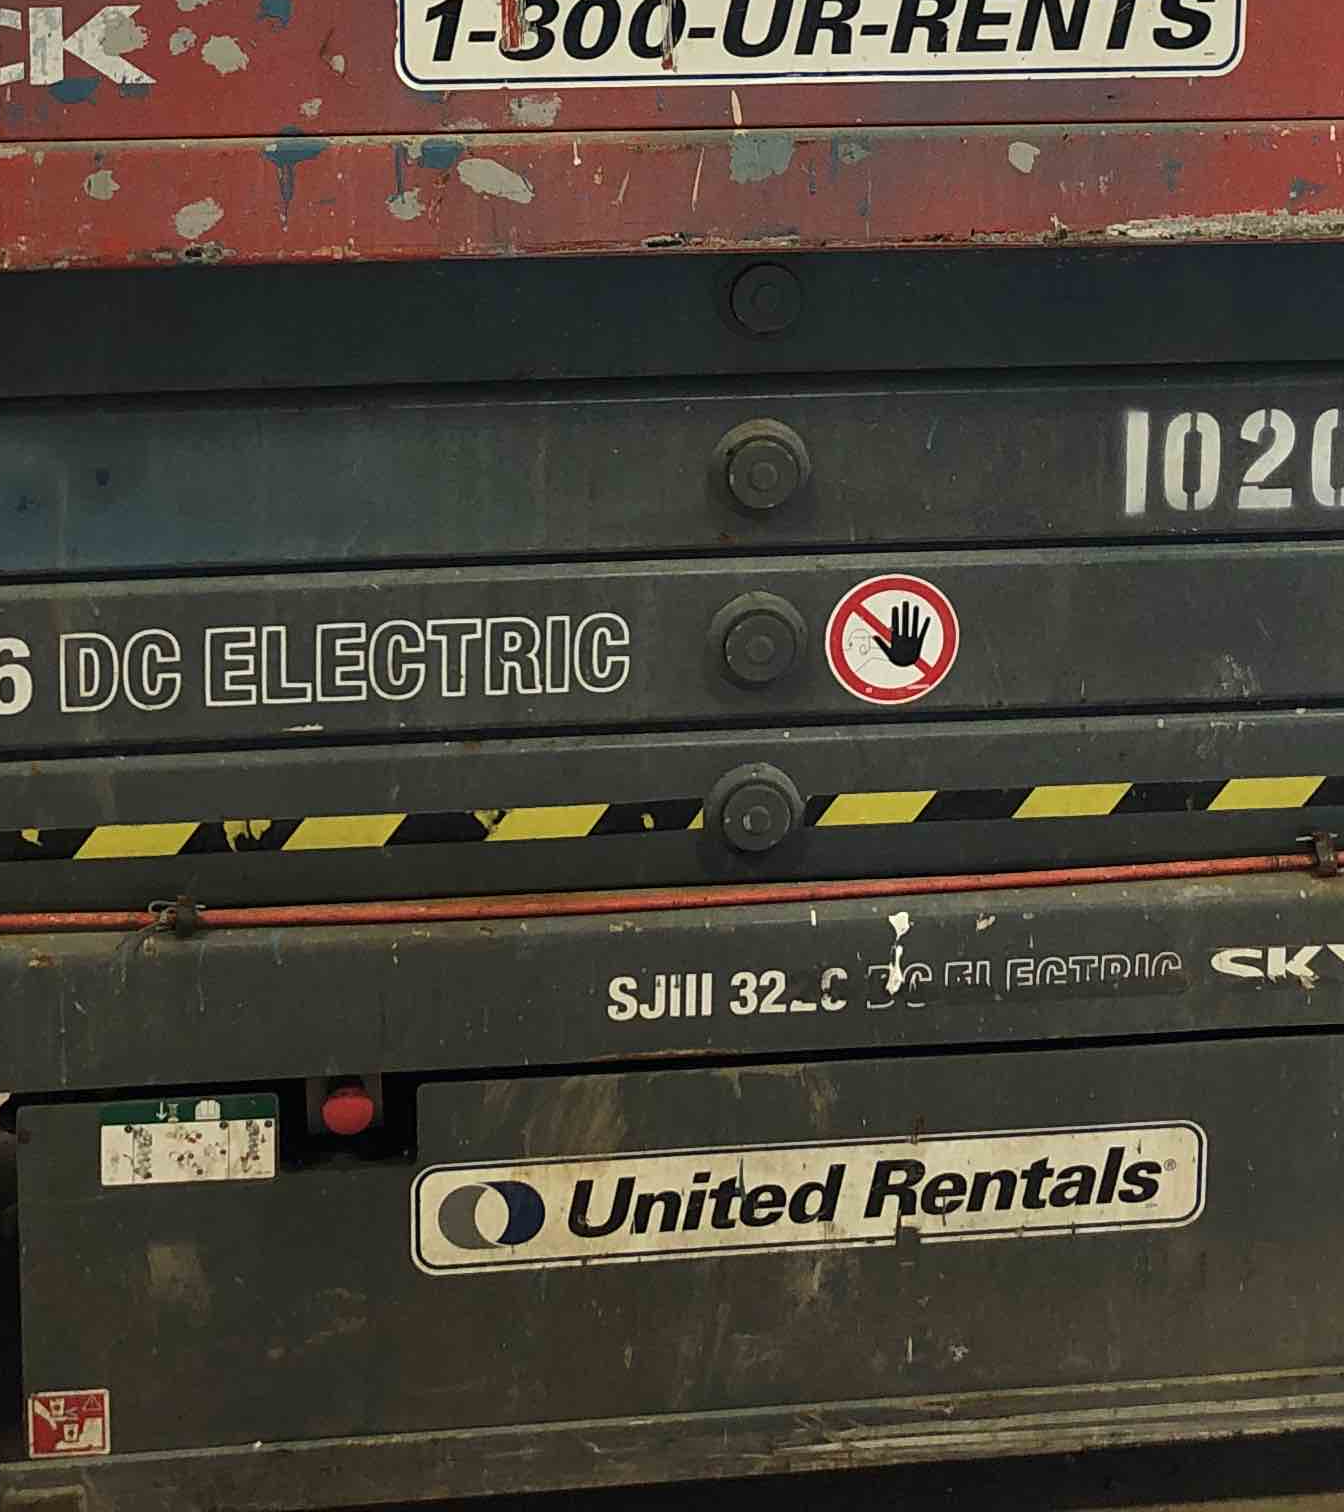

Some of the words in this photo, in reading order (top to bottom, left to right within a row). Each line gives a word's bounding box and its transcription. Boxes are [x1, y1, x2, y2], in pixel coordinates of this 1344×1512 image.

[59, 627, 183, 714] DC
[202, 611, 631, 709] ELECTRIC
[607, 971, 713, 1020] SJIII
[568, 1162, 846, 1239] United
